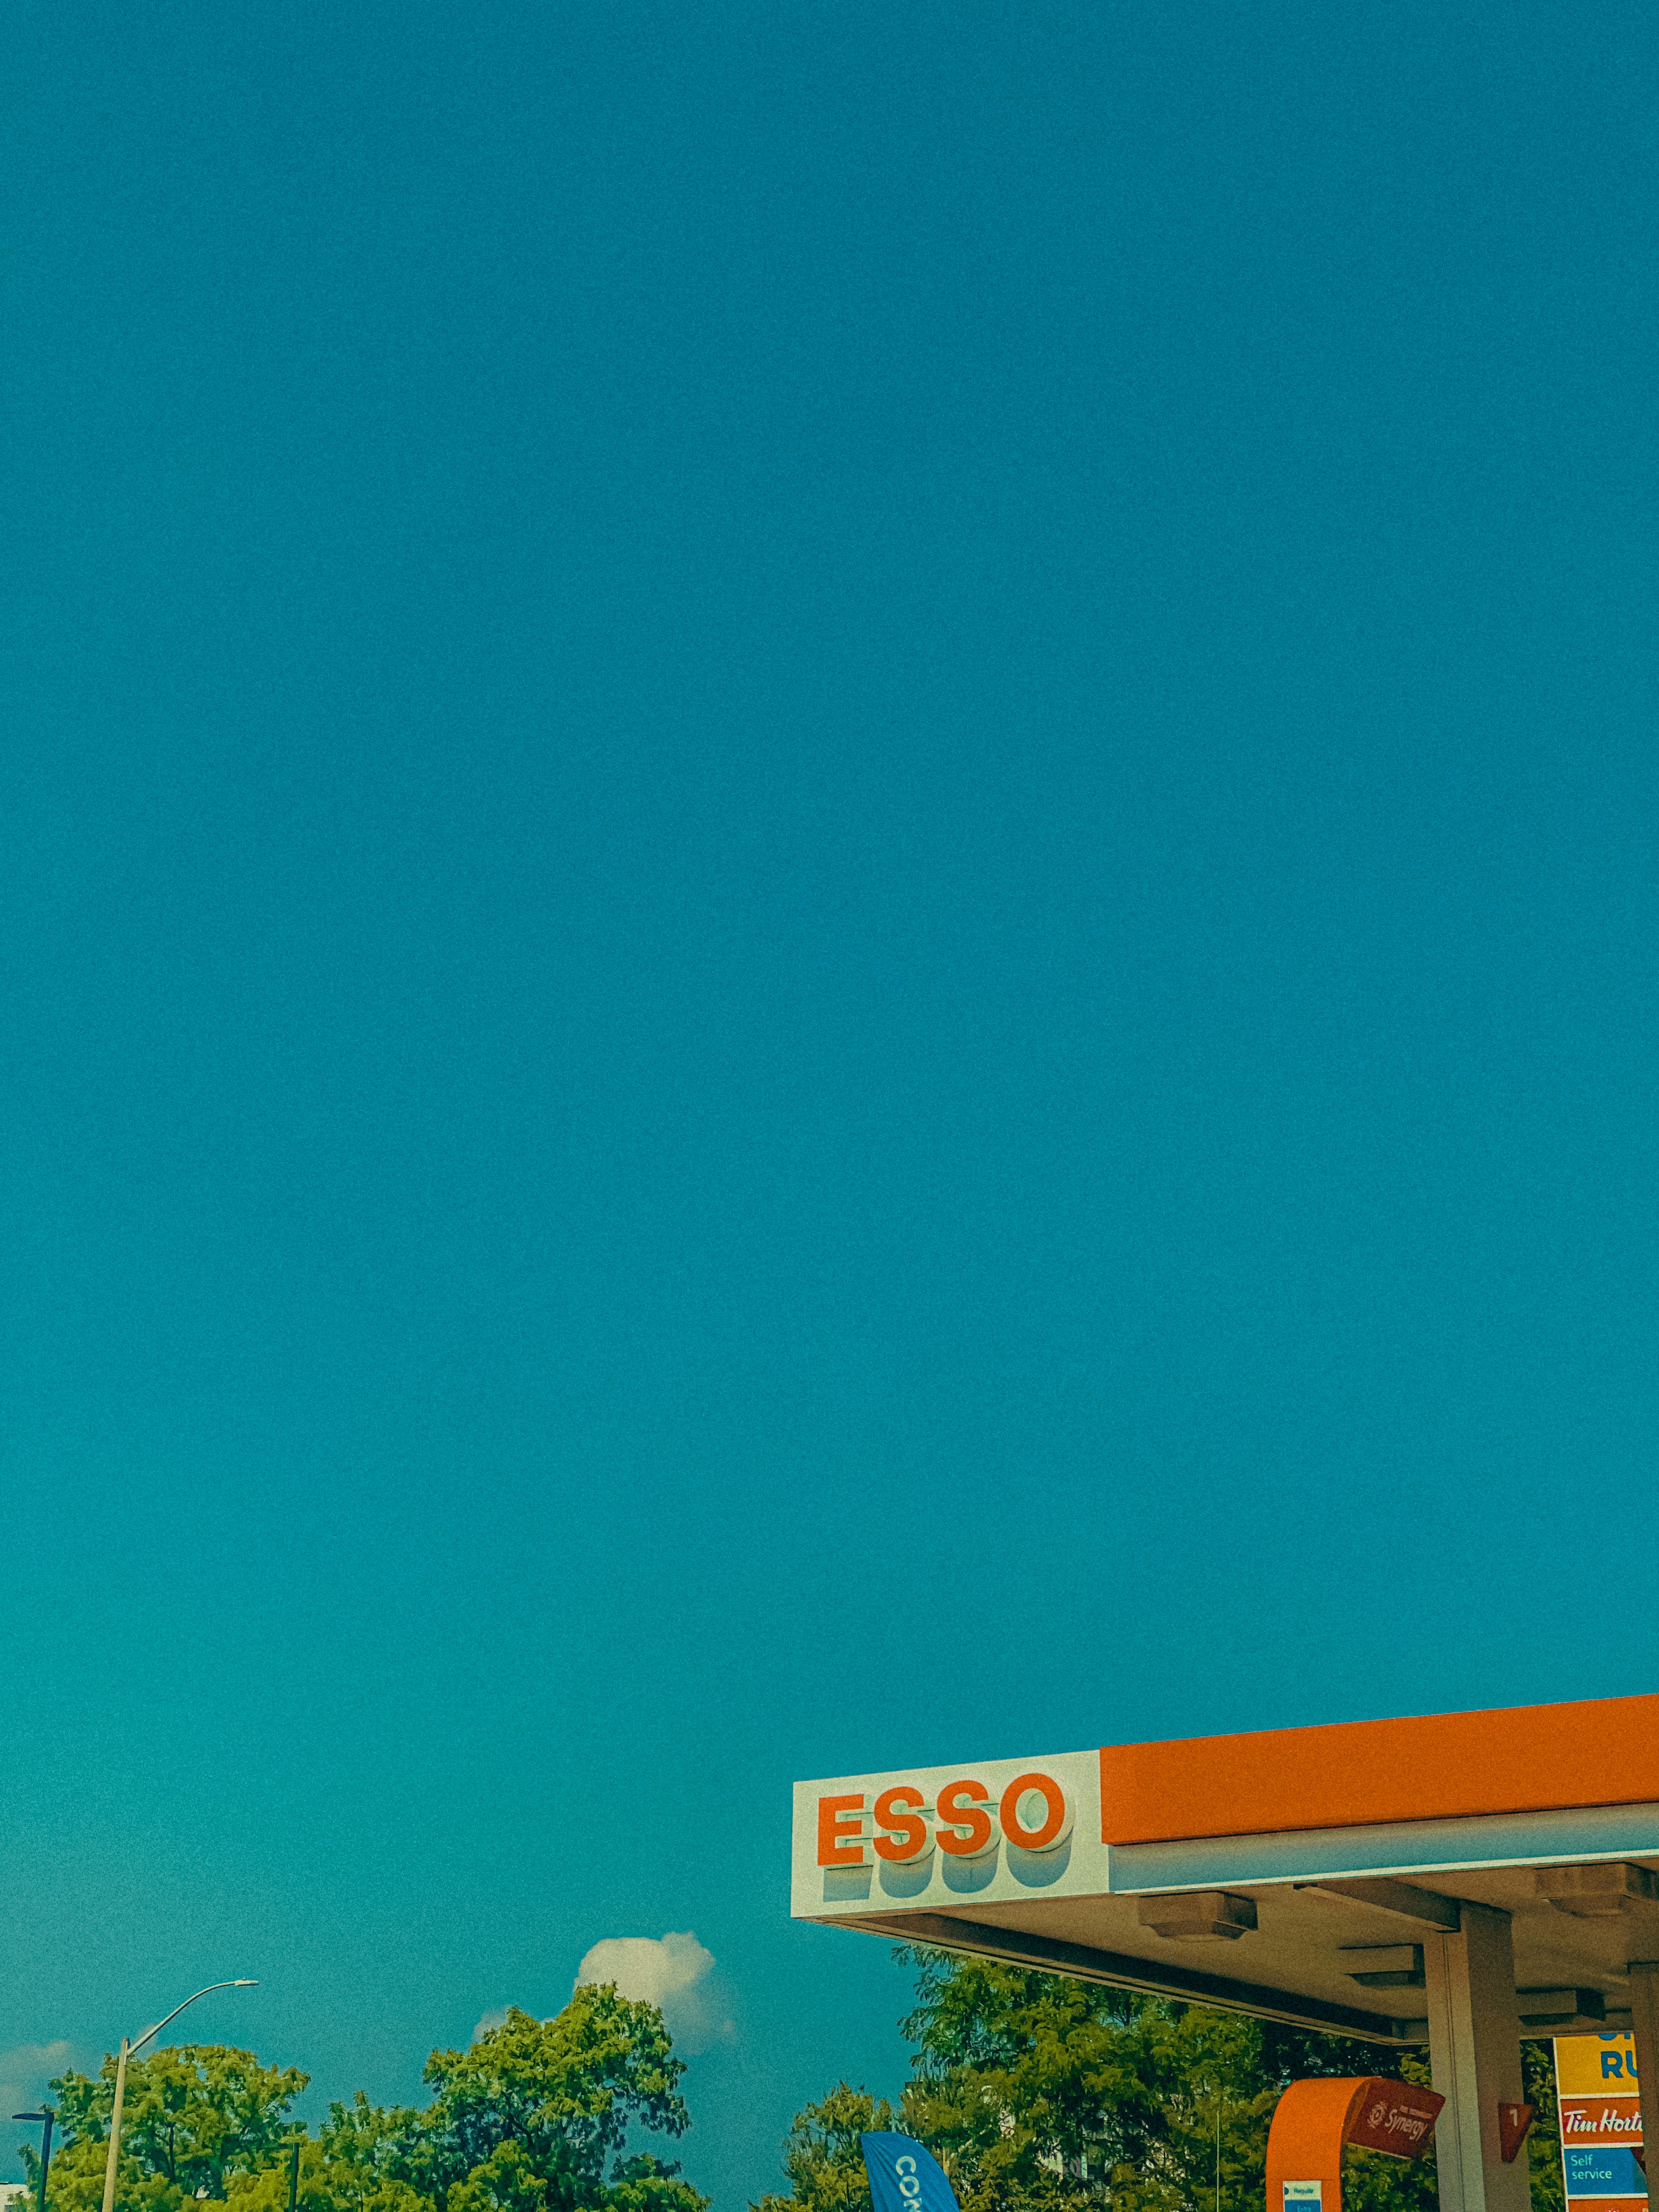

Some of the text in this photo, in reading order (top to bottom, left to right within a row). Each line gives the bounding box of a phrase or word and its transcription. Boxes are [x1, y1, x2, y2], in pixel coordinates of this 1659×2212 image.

[817, 1773, 1065, 1866] ESSO
[1384, 2108, 1429, 2141] Synergy
[1509, 2108, 1518, 2126] 1
[1564, 2108, 1643, 2134] Tim Hort
[1570, 2154, 1593, 2166] Self
[1572, 2168, 1612, 2180] service
